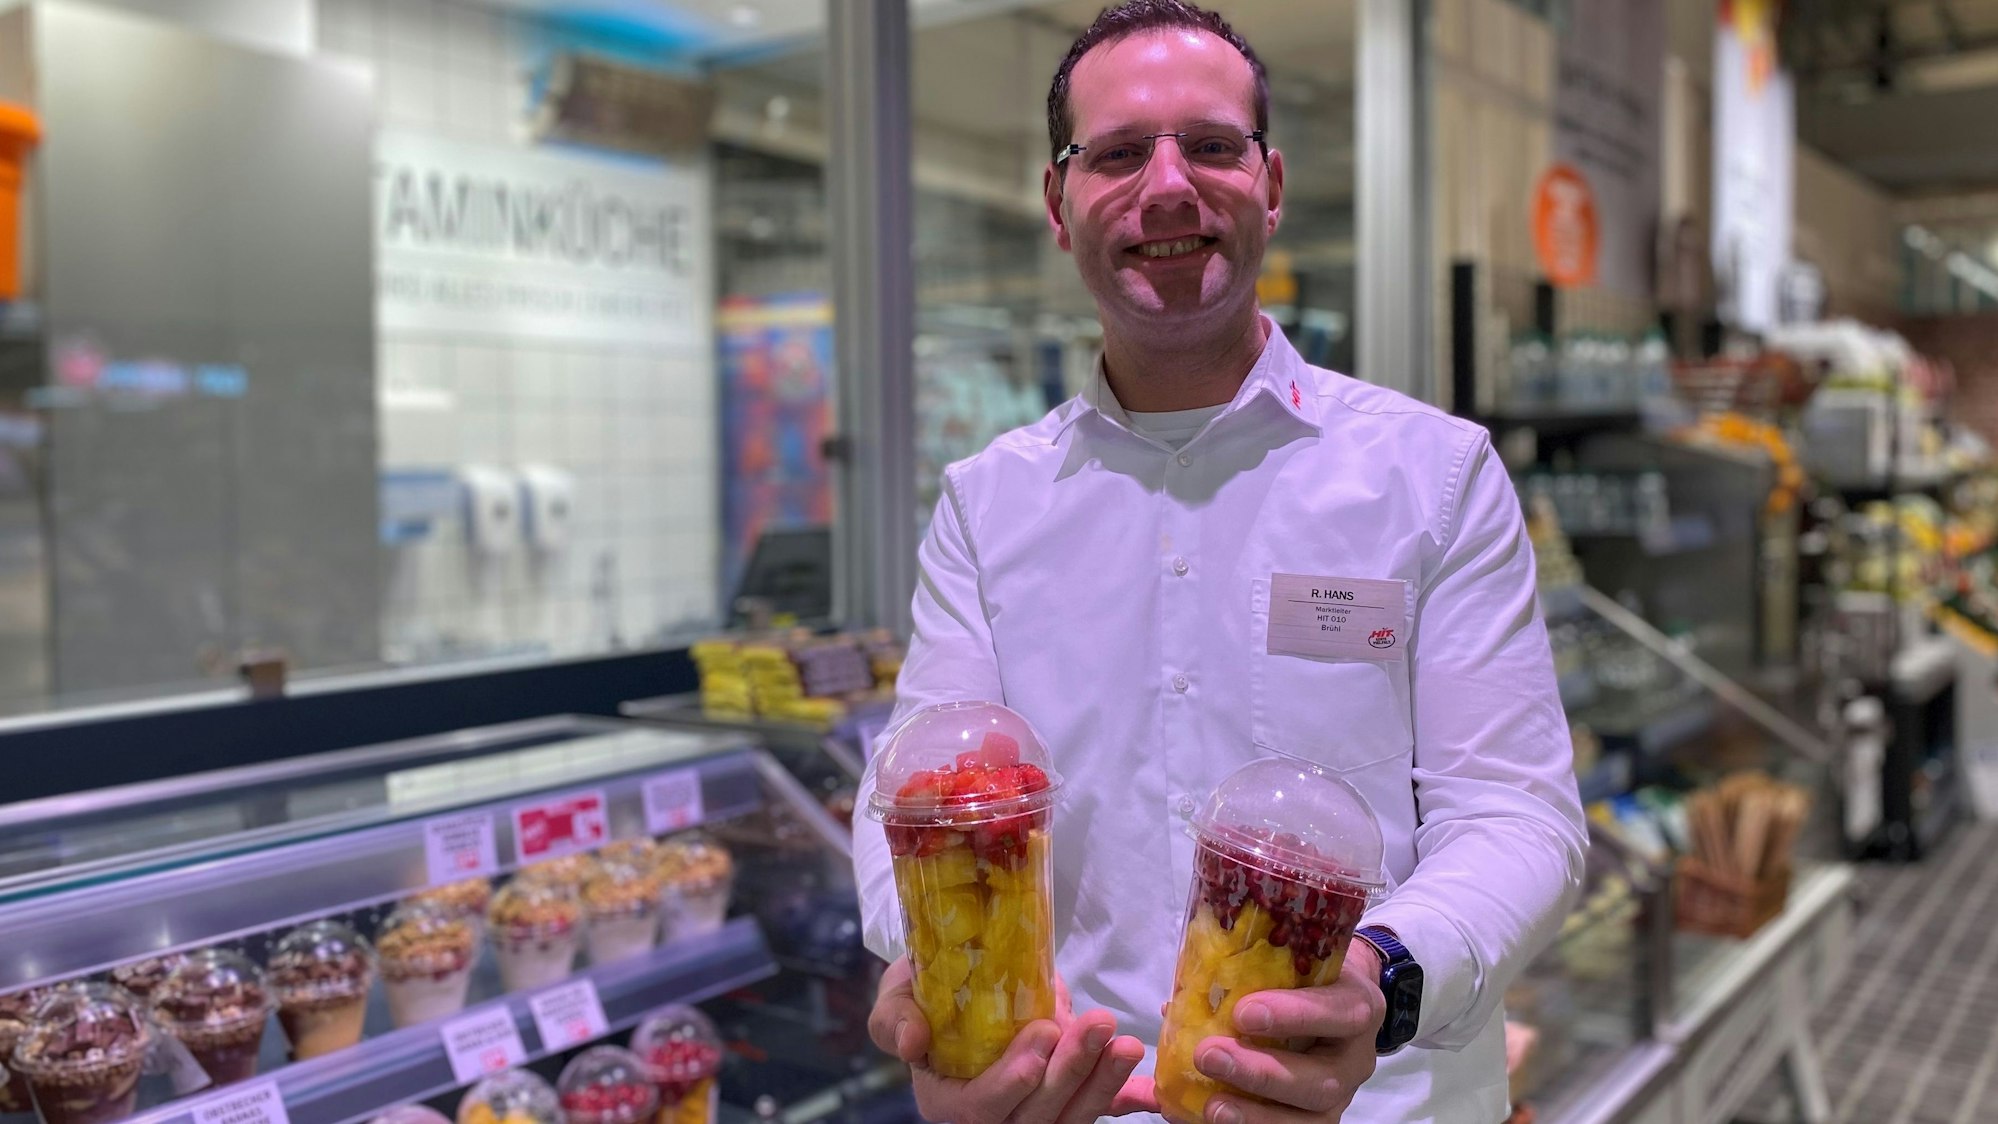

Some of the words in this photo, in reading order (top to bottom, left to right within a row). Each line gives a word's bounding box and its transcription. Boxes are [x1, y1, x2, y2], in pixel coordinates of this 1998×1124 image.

[1311, 588, 1322, 598] R.
[1324, 589, 1354, 601] HANS
[1315, 606, 1351, 615] Marktleiter
[1331, 615, 1347, 623] 010
[1321, 624, 1341, 632] Brühl
[1371, 629, 1394, 638] HIT
